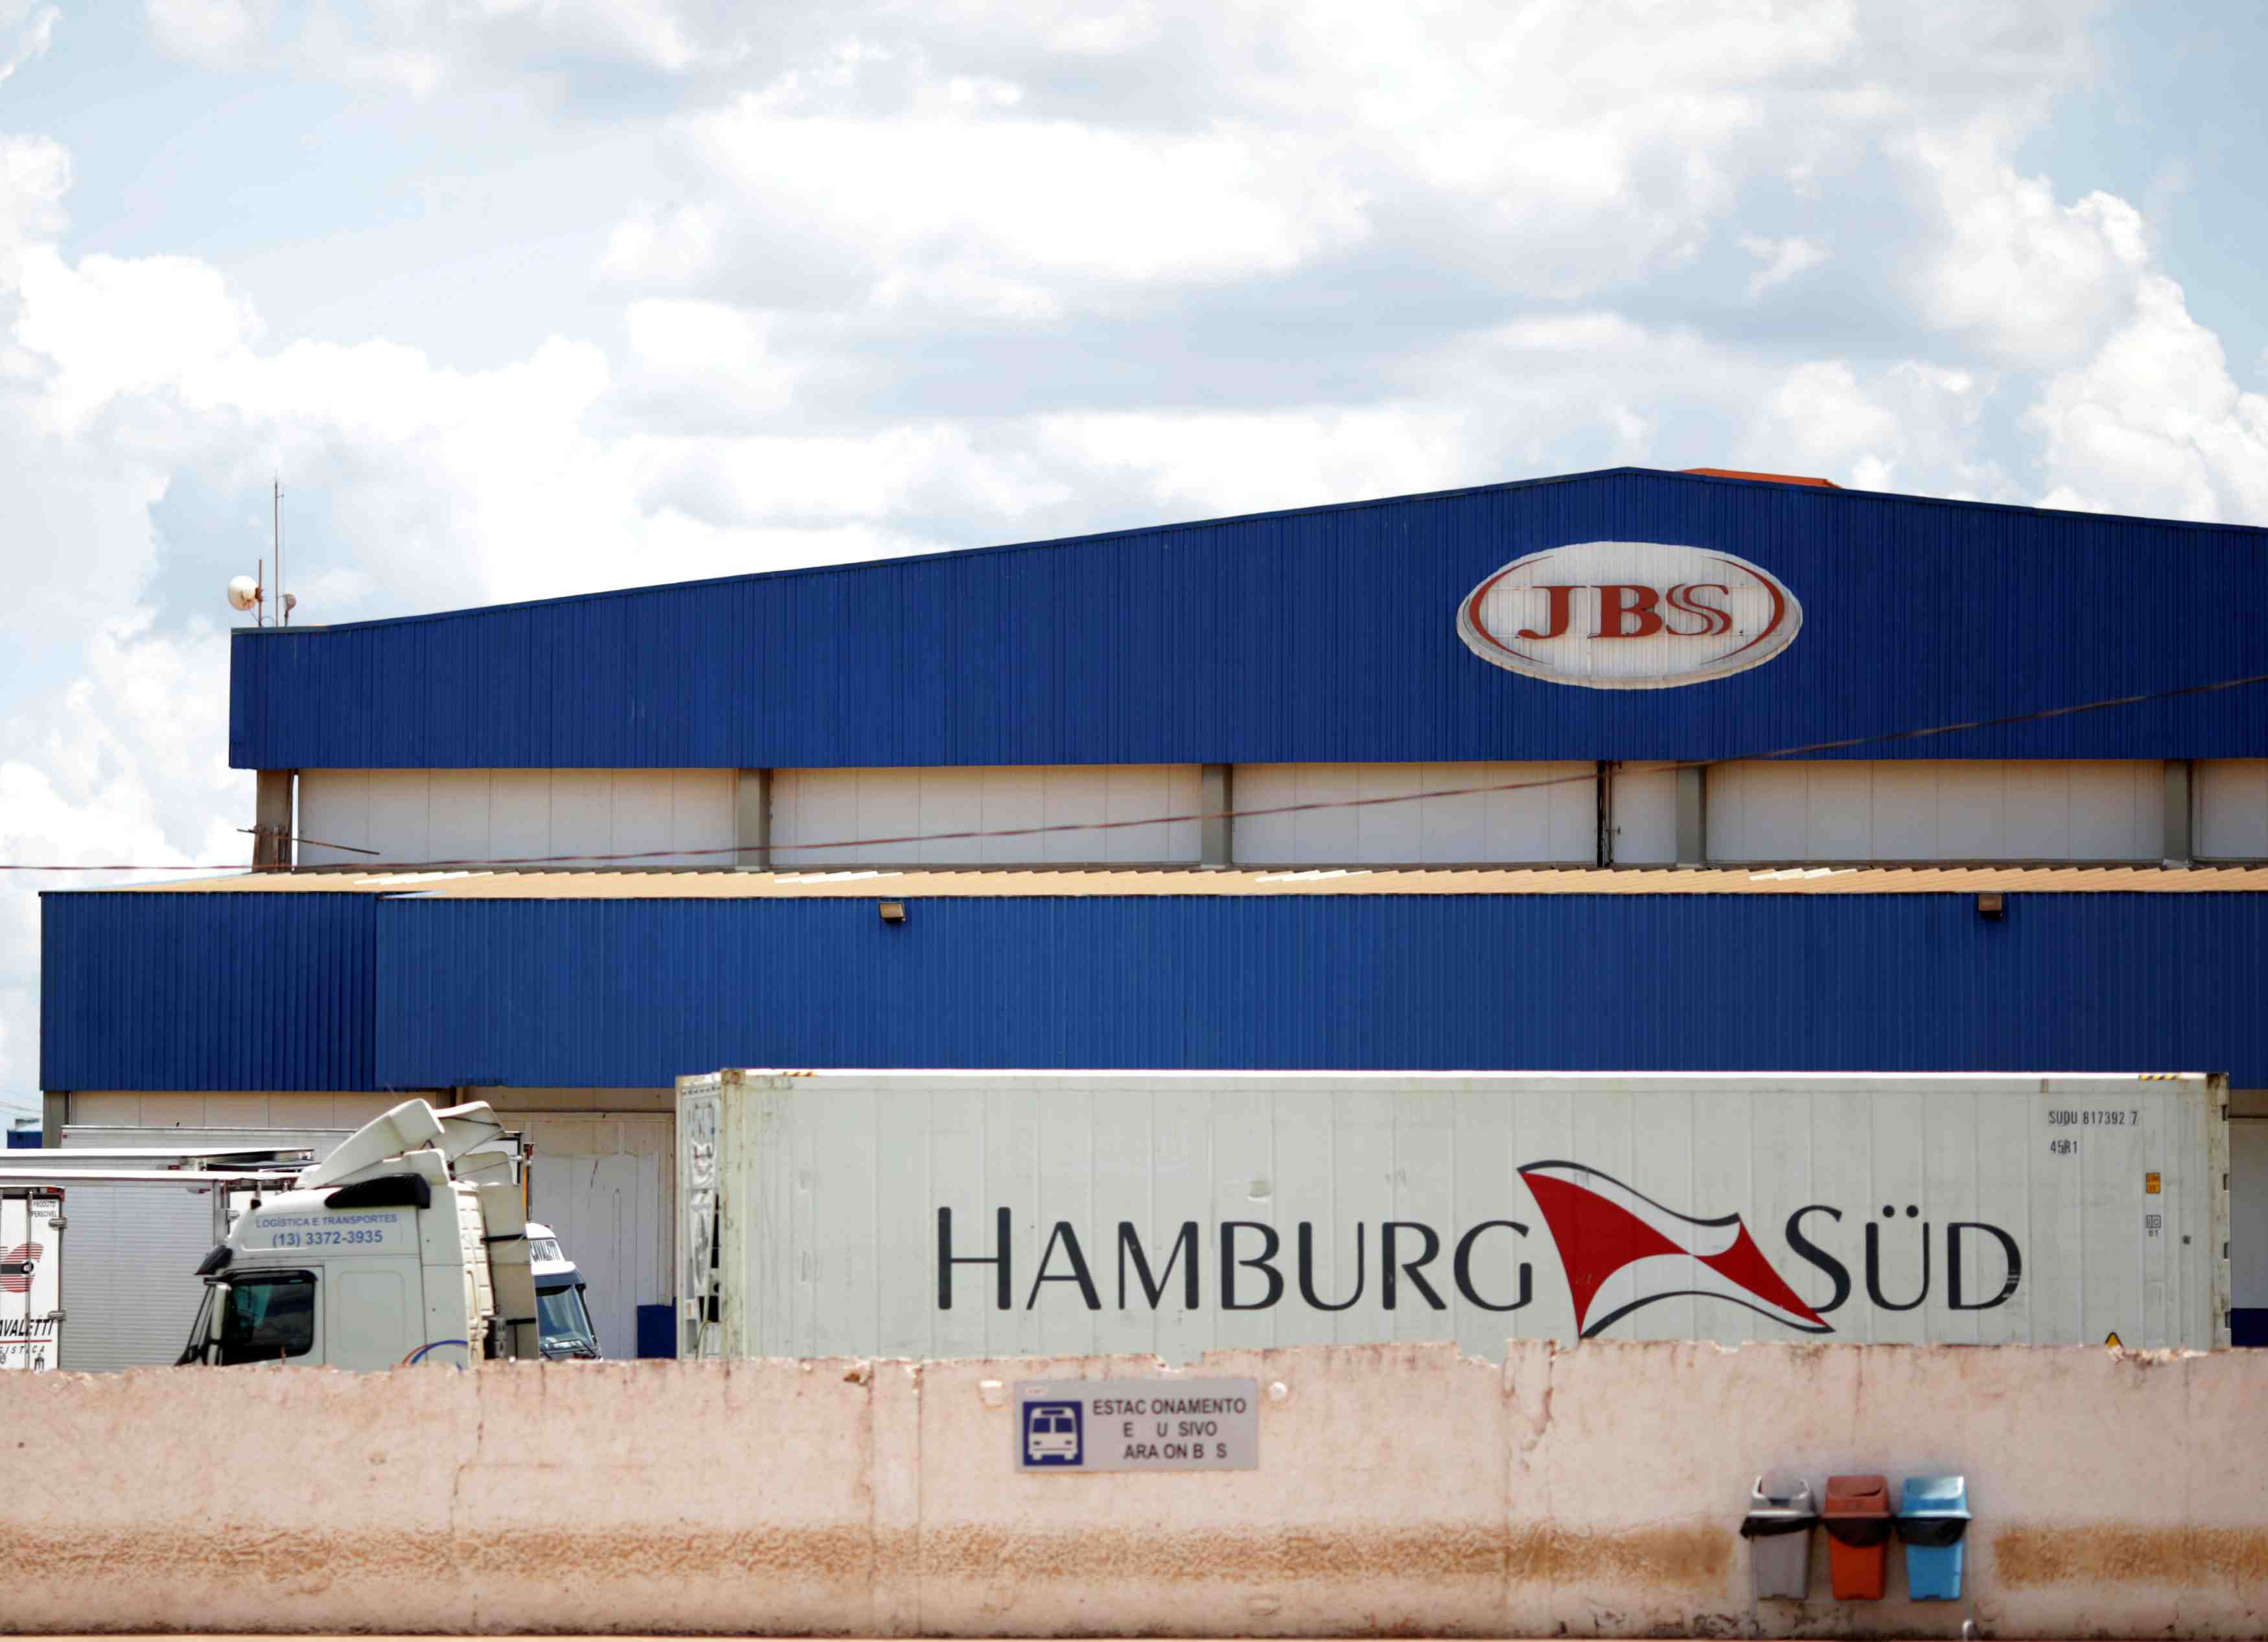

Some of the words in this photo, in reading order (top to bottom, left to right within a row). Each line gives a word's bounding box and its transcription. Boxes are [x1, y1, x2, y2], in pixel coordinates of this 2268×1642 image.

[1517, 583, 1732, 640] JBS
[2048, 1111, 2077, 1125] SUDU
[2083, 1111, 2125, 1125] 817392
[2131, 1111, 2138, 1125] 7
[2050, 1140, 2077, 1154] 45R1
[312, 1217, 318, 1226] E
[323, 1214, 397, 1225] TRANSPORTES
[272, 1232, 301, 1247] (13)
[306, 1230, 383, 1245] 3372-3935
[938, 1207, 1533, 1312] HAMBURG
[1785, 1205, 2022, 1313] SÜD
